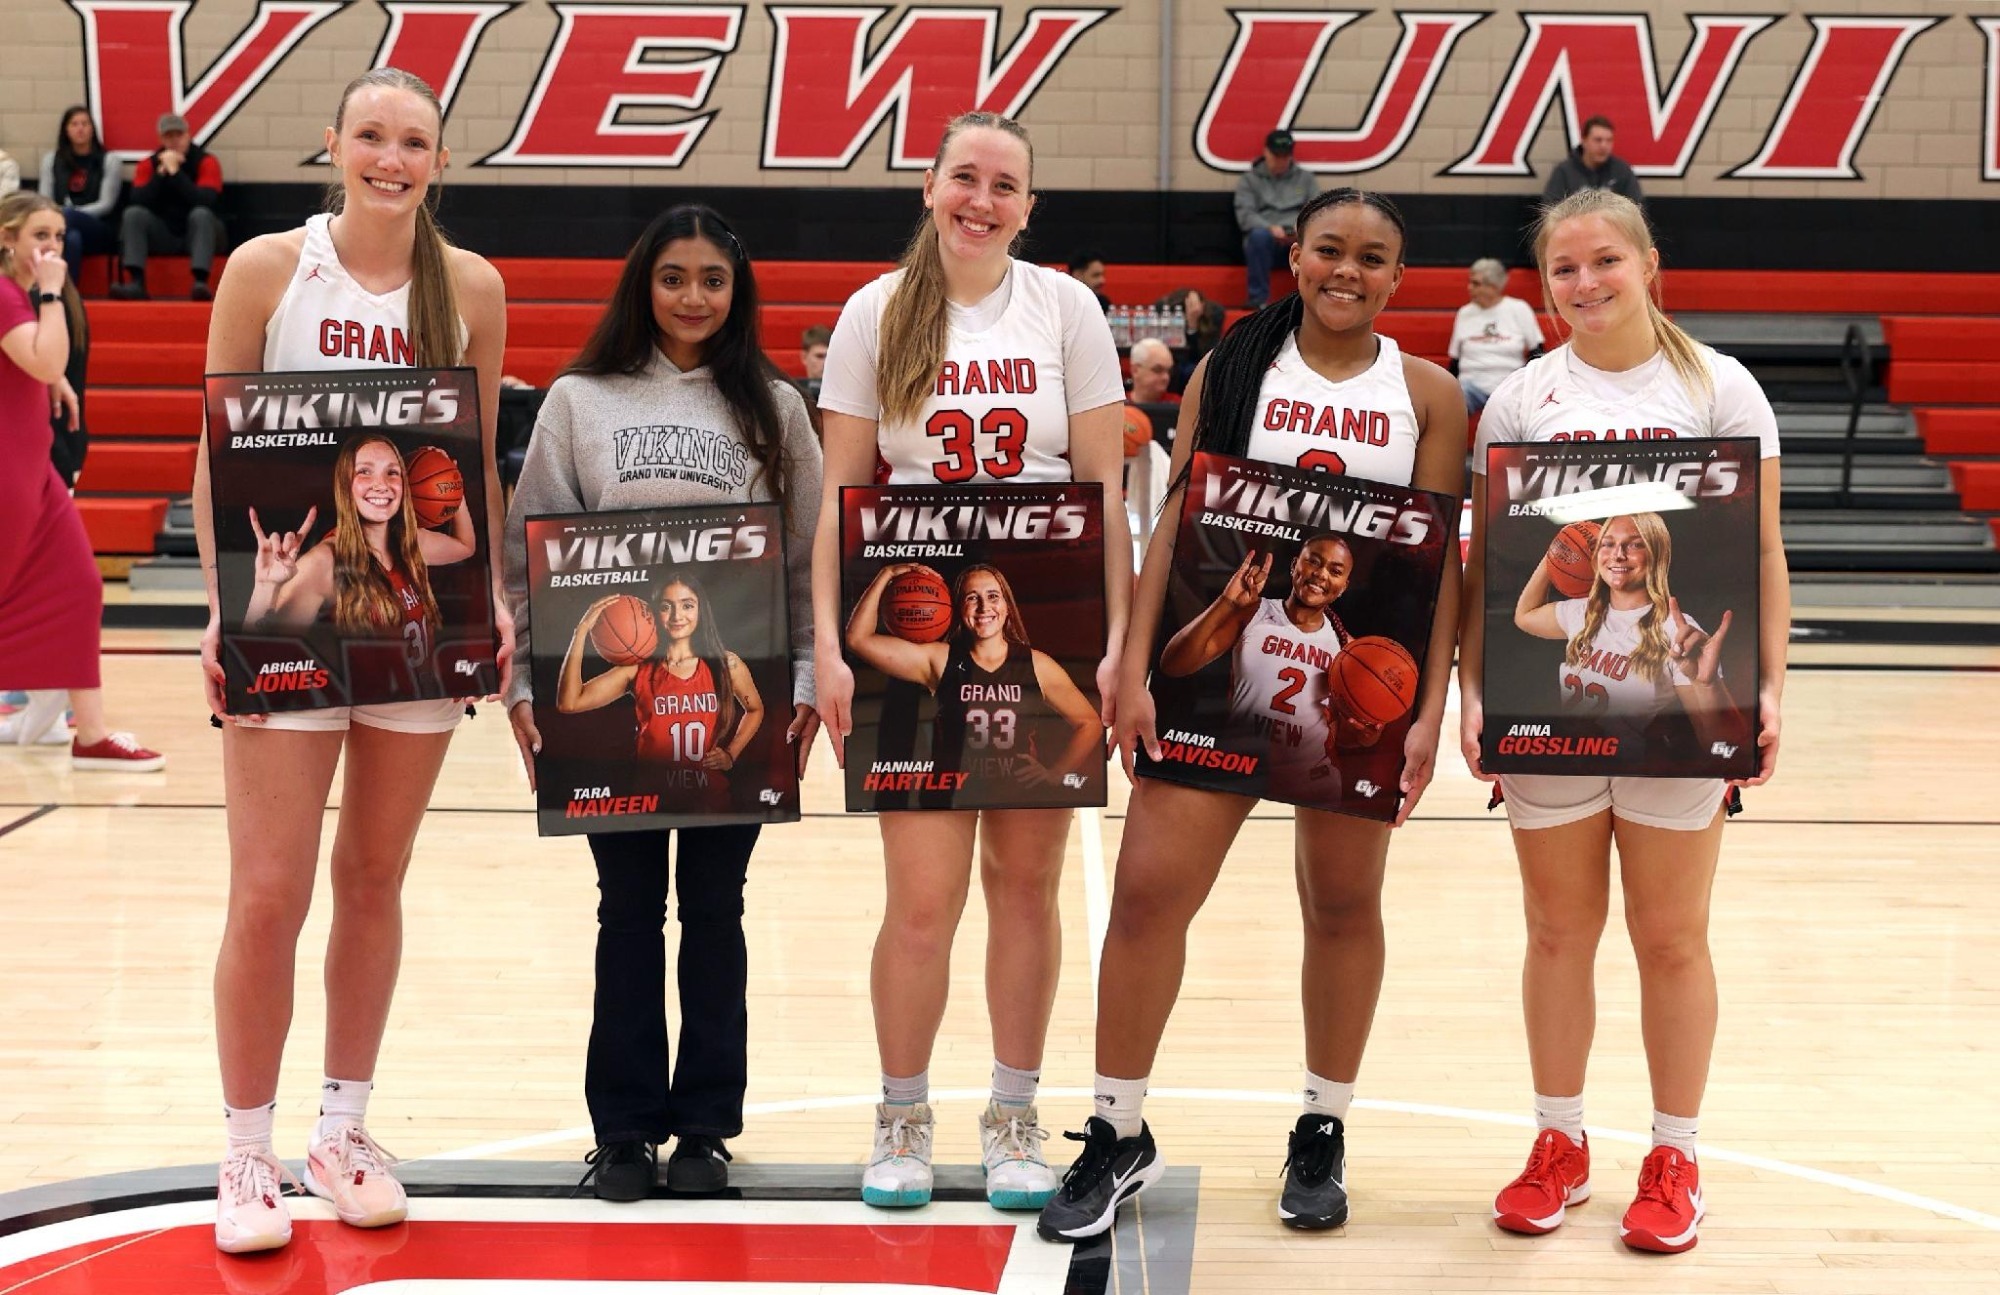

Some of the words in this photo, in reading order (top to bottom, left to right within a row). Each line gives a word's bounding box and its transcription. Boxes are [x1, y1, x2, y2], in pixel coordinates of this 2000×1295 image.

[66, 0, 1120, 171] VIEW
[1193, 8, 2000, 182] UNI
[319, 318, 418, 366] GRAN
[936, 358, 1037, 396] RAND
[224, 388, 460, 432] VIKINGS
[1263, 398, 1390, 448] GRAND
[230, 432, 338, 450] BASKETBALL
[926, 408, 1028, 484] 33
[613, 425, 749, 487] VIKINGS
[619, 469, 652, 484] GRAND
[653, 468, 678, 480] VIEW
[679, 470, 735, 495] UNIVERSITY
[1506, 461, 1741, 500] VIKINGS
[859, 505, 1087, 541] VIKINGS
[1204, 473, 1433, 546] VIKINGS
[1200, 512, 1301, 542] BASKETBALL
[545, 525, 768, 572] VIKINGS
[863, 544, 964, 558] BASKETBALL
[550, 569, 650, 588] BASKETBALL
[259, 659, 317, 675] ABIGAIL
[1261, 634, 1334, 673] GRAND
[246, 669, 329, 695] JONES
[960, 684, 1021, 702] GRAND
[1269, 667, 1308, 716] 2
[654, 692, 719, 716] GRAND
[669, 721, 706, 762] 10
[965, 708, 1017, 749] 33
[1163, 728, 1216, 749] AMAYA
[1508, 724, 1551, 737] ANNA
[1497, 736, 1620, 757] GOSSLING
[666, 768, 710, 789] VIEW
[871, 761, 934, 773] HANNAH
[573, 786, 611, 800] TARA
[863, 773, 970, 792] HARTLEY
[565, 795, 659, 819] NAVEEN
